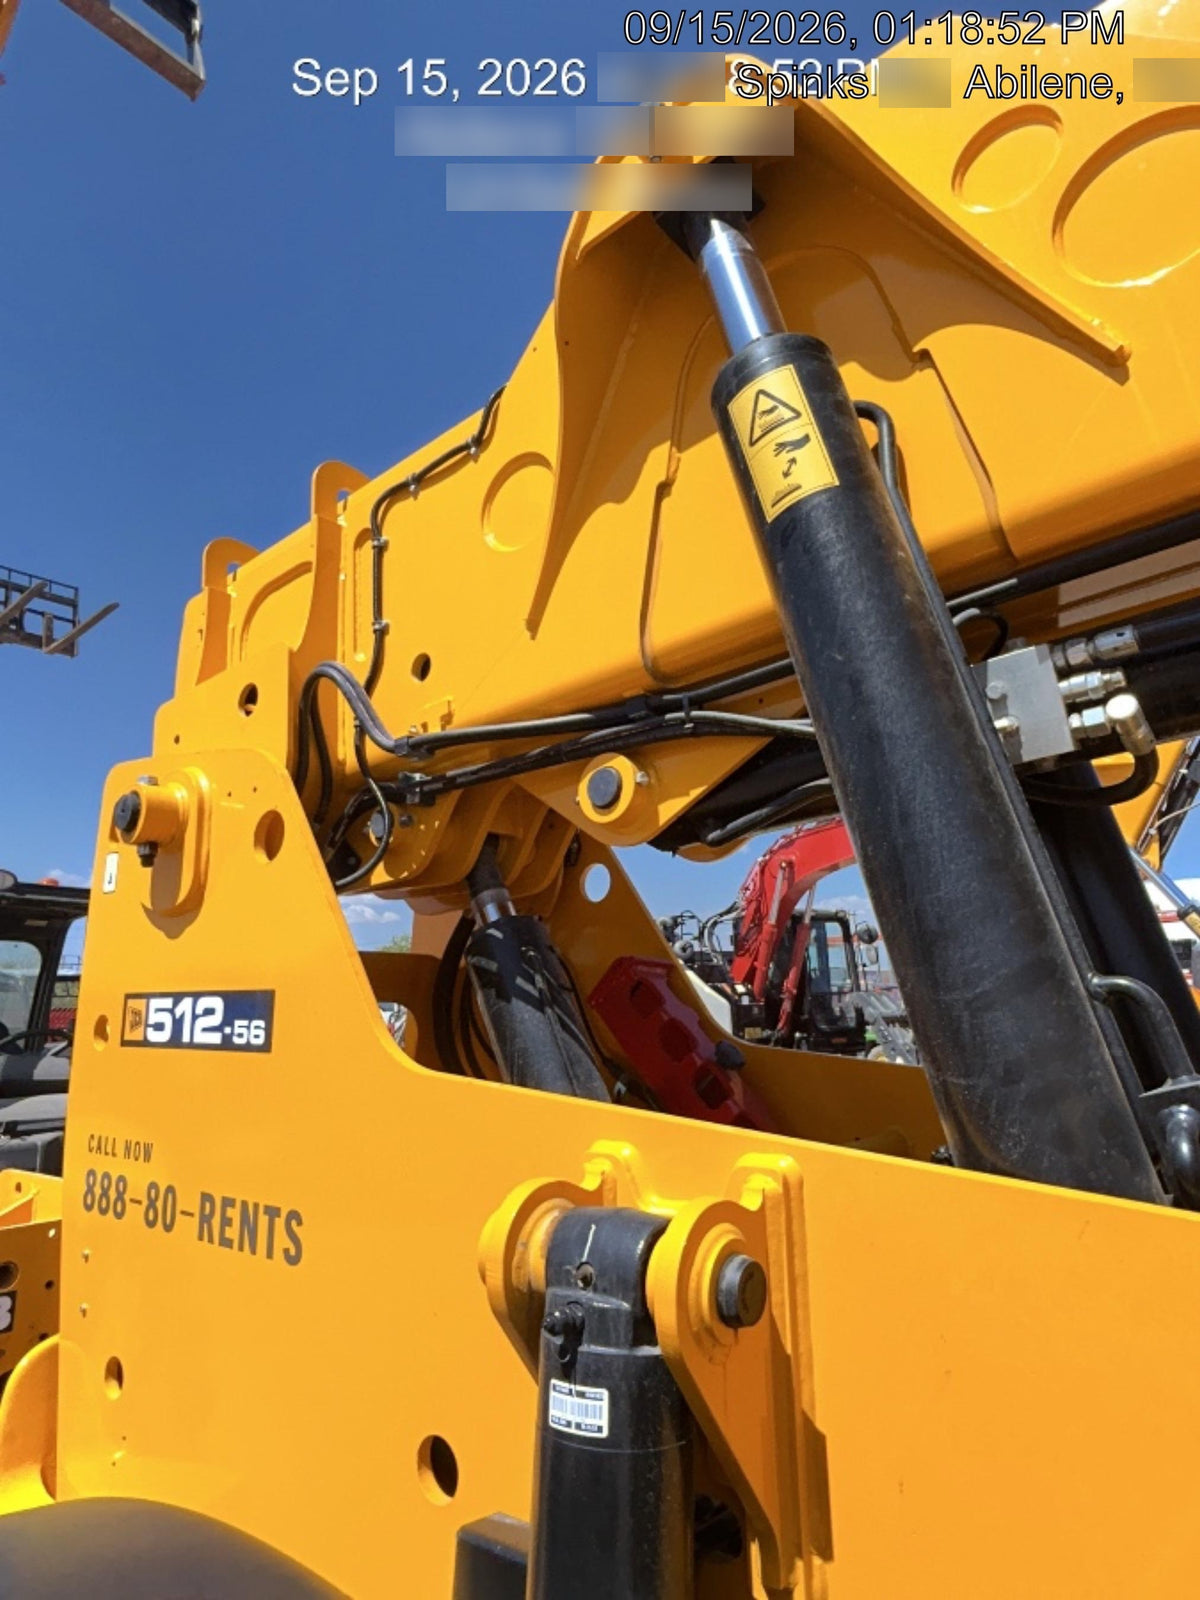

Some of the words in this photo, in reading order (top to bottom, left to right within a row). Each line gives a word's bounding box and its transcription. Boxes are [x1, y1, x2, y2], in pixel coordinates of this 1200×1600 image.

[87, 1133, 118, 1159] CALL
[123, 1139, 154, 1164] NOW
[82, 1168, 304, 1267] 888-80-RENTS
